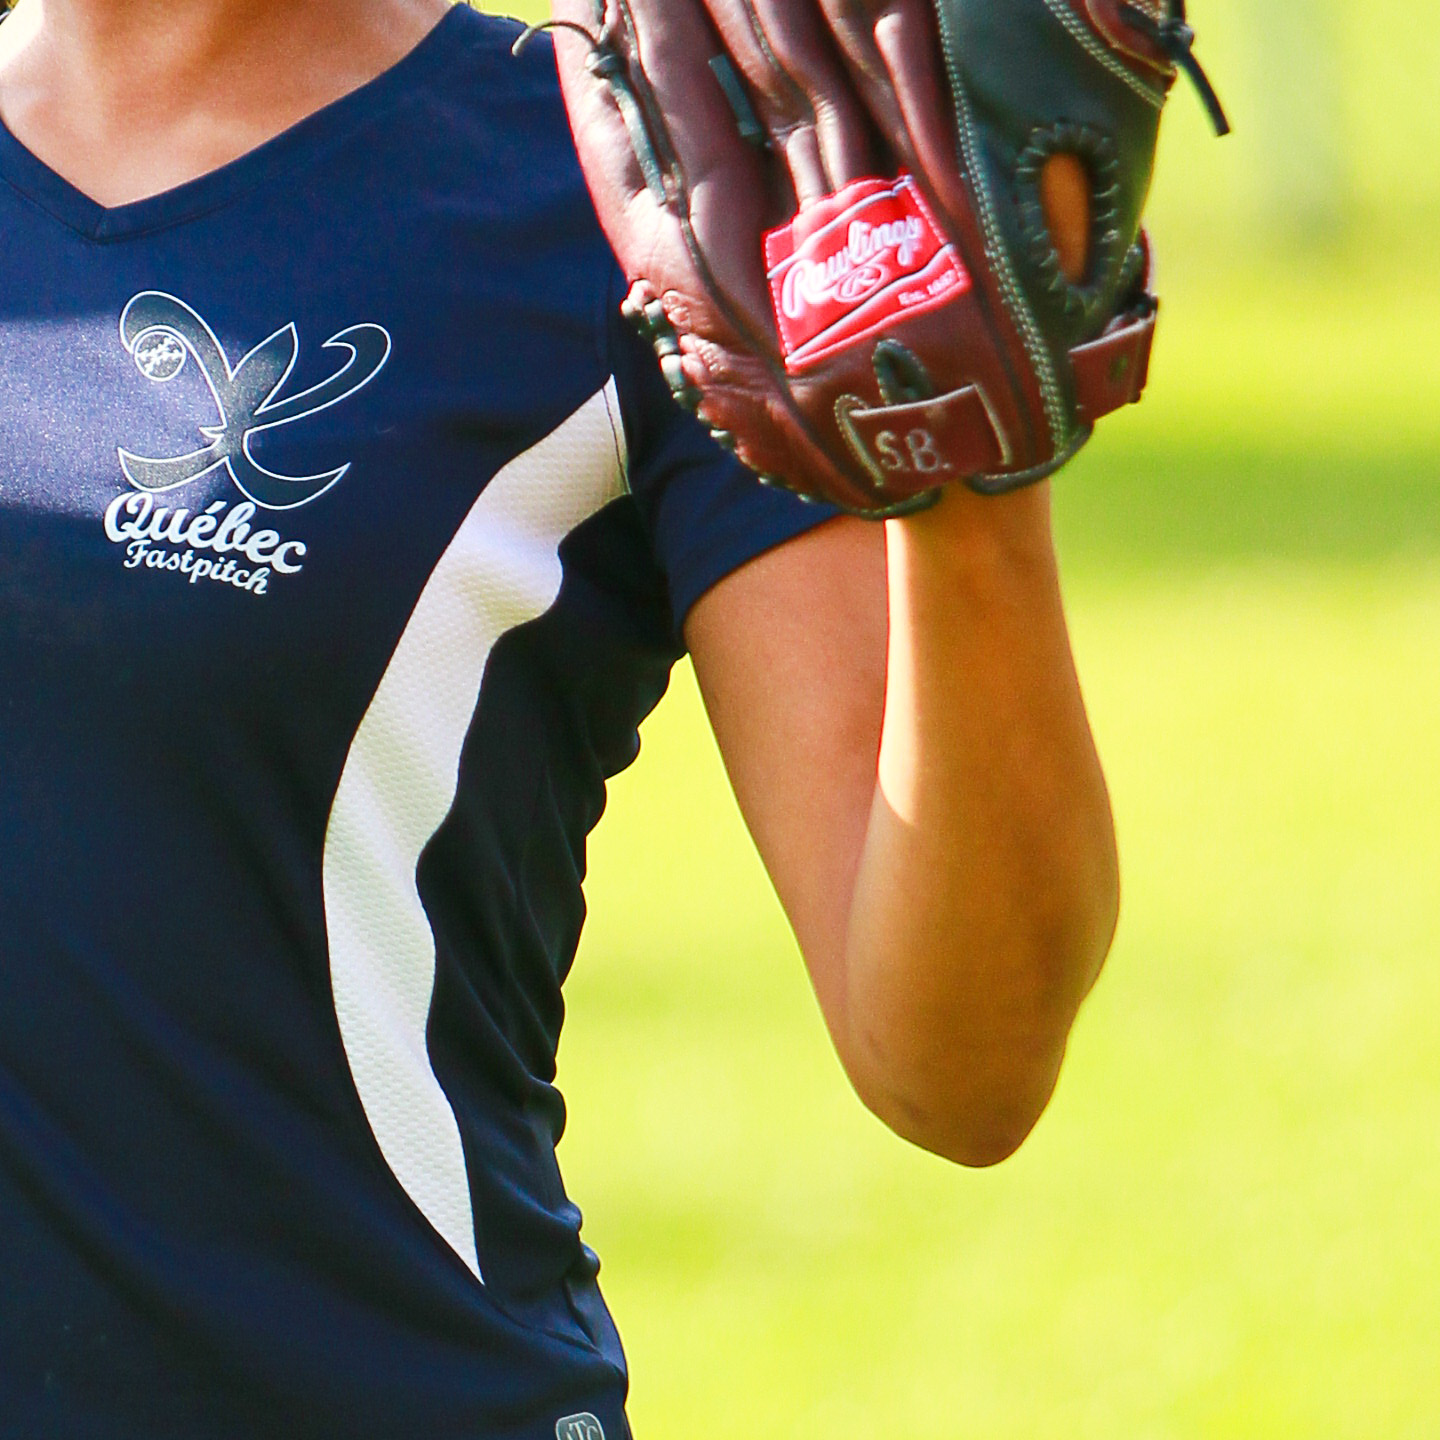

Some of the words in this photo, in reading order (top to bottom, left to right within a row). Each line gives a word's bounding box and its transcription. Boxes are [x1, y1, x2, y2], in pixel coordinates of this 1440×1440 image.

[781, 215, 922, 318] Rawlings
[104, 491, 307, 574] Québec
[123, 539, 270, 595] Fastpitch
